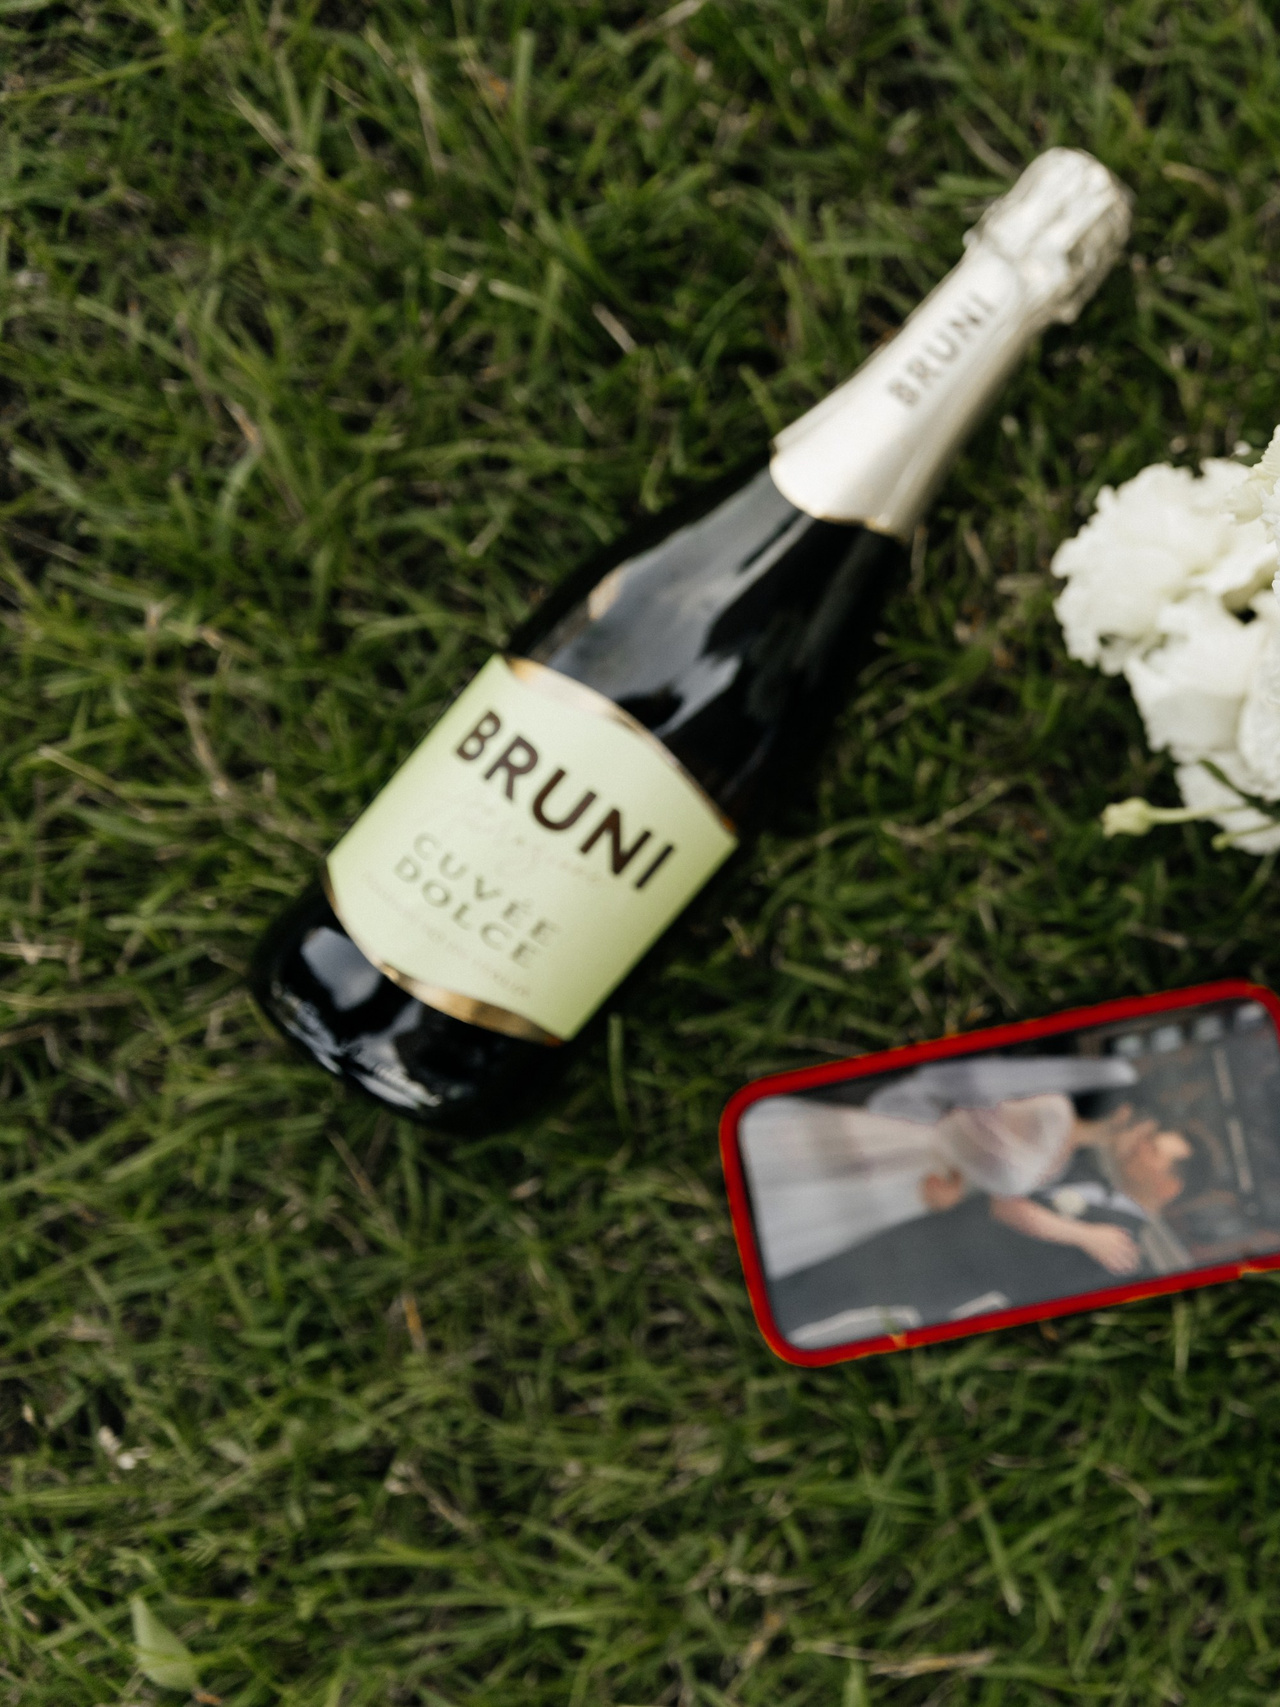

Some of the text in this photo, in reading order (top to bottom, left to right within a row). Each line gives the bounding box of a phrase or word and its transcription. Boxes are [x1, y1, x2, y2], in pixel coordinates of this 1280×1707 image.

[887, 291, 996, 407] BRUNI
[454, 709, 675, 890] BRUNI
[393, 855, 538, 968] DOLCE
